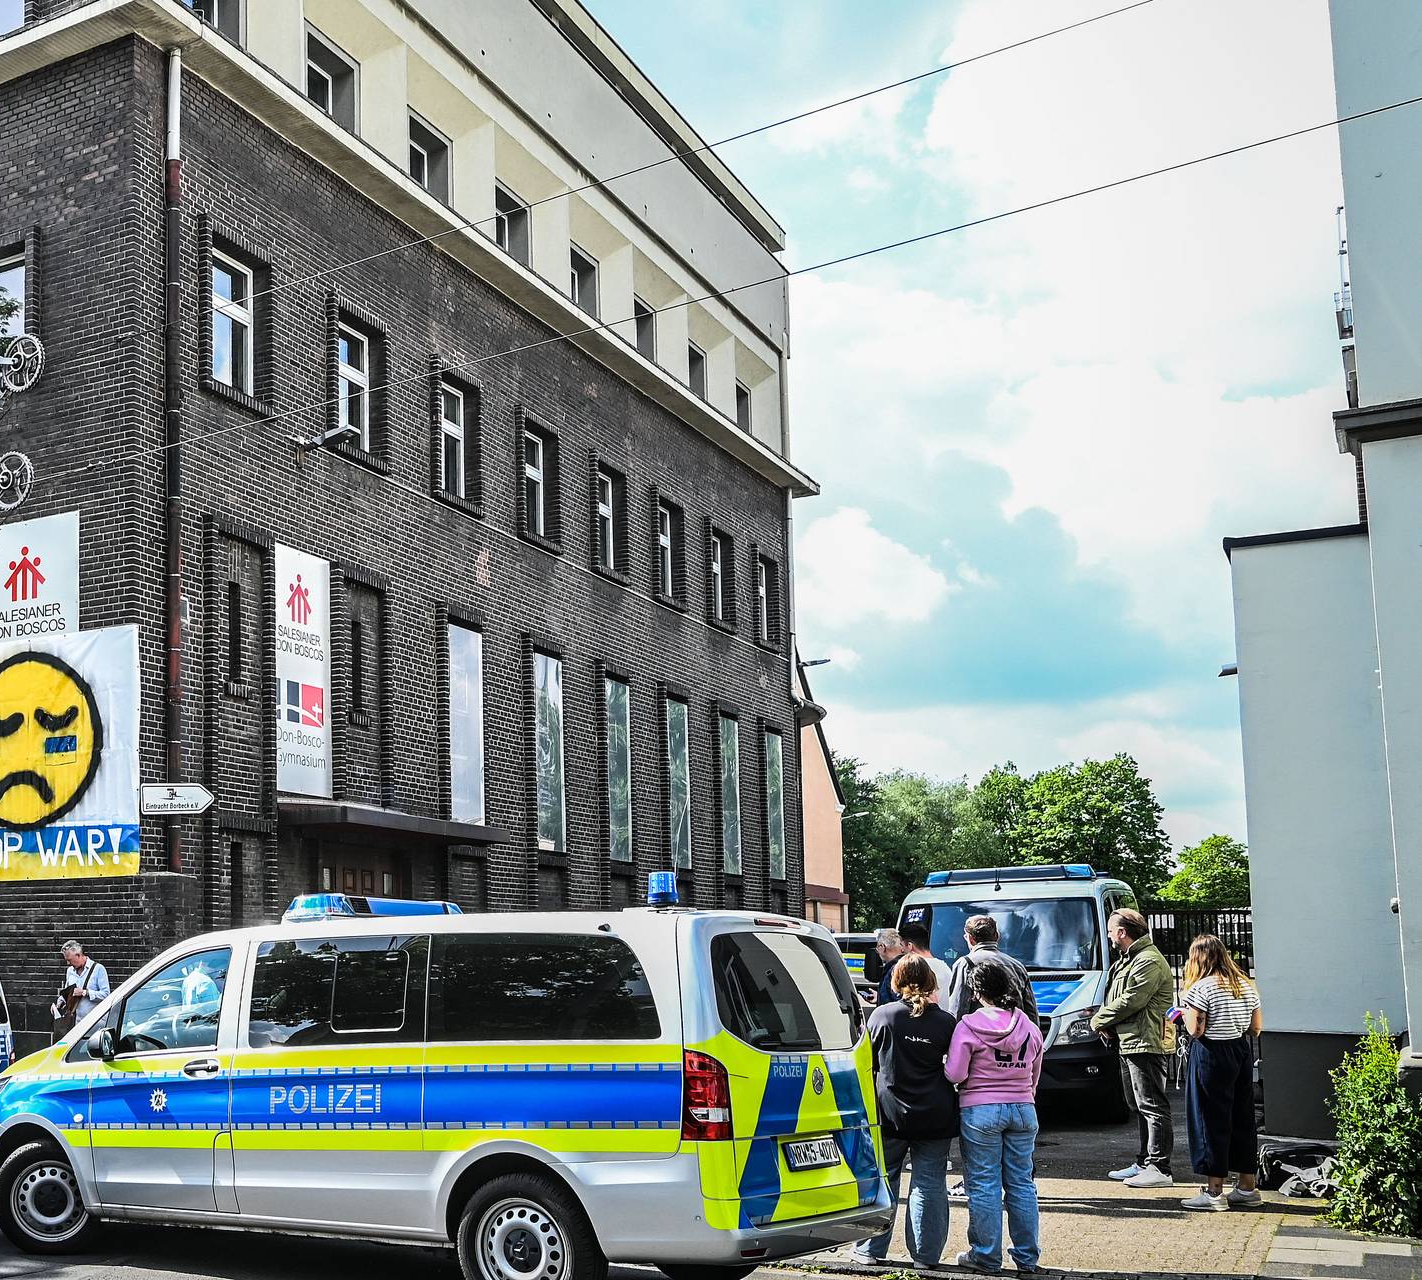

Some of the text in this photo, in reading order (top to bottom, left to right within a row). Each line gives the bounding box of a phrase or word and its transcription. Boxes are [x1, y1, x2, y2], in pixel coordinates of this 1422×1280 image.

[16, 617, 66, 637] BOSCOS
[277, 624, 321, 647] SALESIANER
[294, 643, 324, 662] BOSCOS
[35, 827, 123, 867] WAR!
[773, 1064, 803, 1078] POLIZEI
[269, 1083, 382, 1115] POLIZEI
